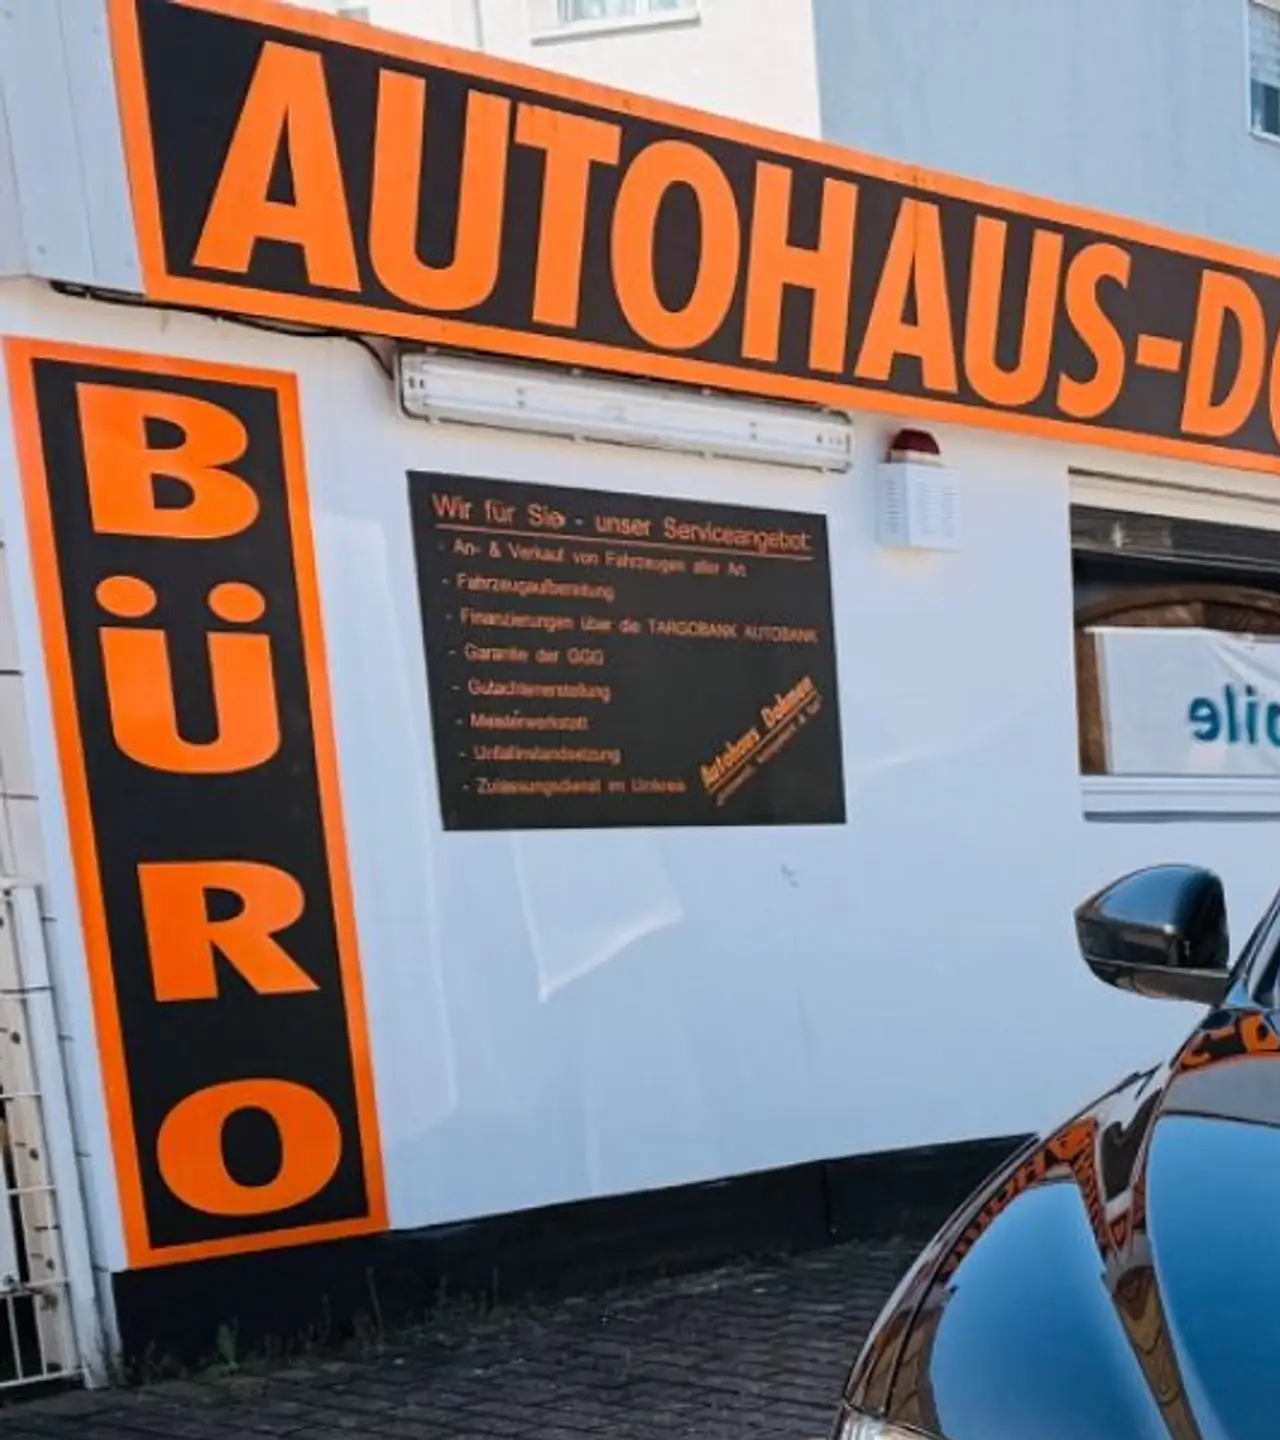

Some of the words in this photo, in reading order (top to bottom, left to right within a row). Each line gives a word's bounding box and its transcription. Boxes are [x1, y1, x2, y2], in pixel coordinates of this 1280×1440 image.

[432, 493, 473, 520] Wir
[484, 499, 516, 523] für
[527, 502, 567, 529] Sie
[595, 513, 652, 538] unser
[489, 540, 502, 559] &
[507, 541, 565, 563] Verkauf
[572, 551, 599, 566] von
[605, 550, 687, 575] Fahrzeugen
[75, 380, 343, 1215] BÜRO
